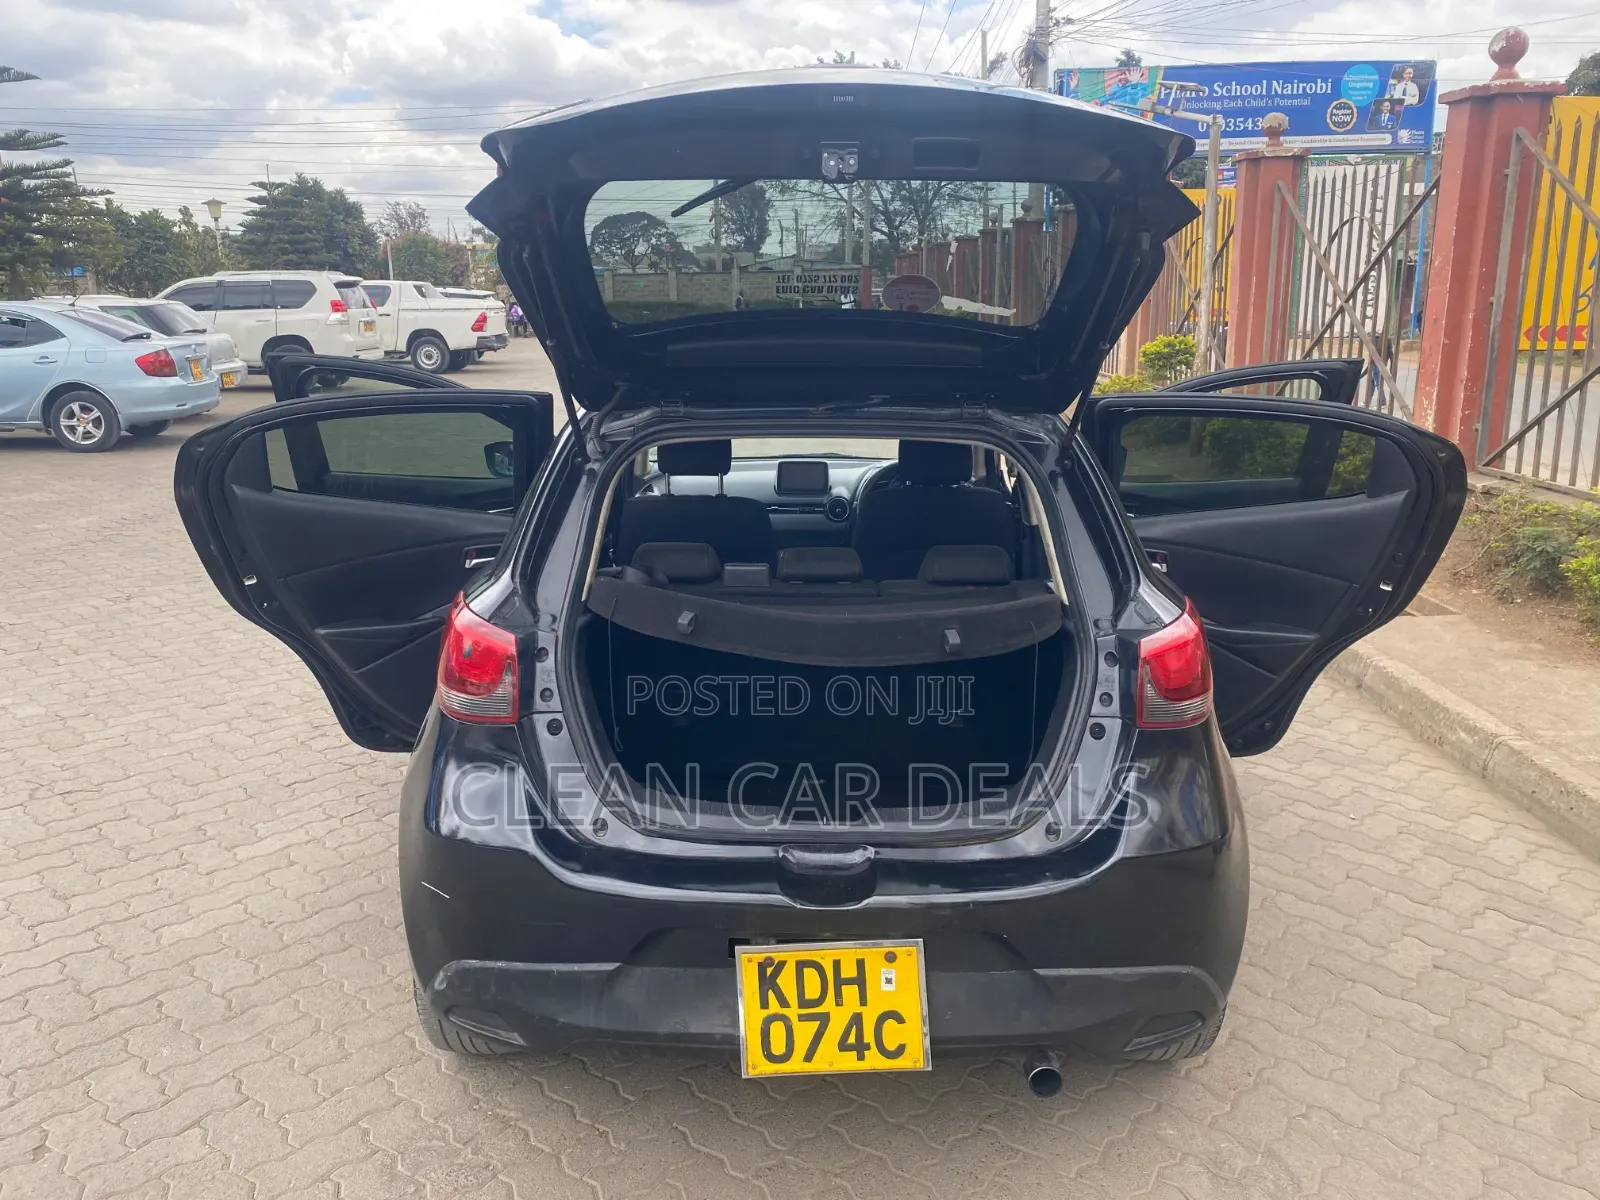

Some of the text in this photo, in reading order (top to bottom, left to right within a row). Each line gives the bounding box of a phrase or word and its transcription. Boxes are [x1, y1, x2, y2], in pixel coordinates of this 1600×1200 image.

[1213, 80, 1267, 97] School
[1271, 78, 1332, 95] Nairobi
[1223, 98, 1243, 108] Each
[1245, 97, 1273, 107] Child's
[1274, 97, 1311, 106] Potential
[757, 957, 868, 1010] KDH
[760, 1010, 907, 1064] 074C
